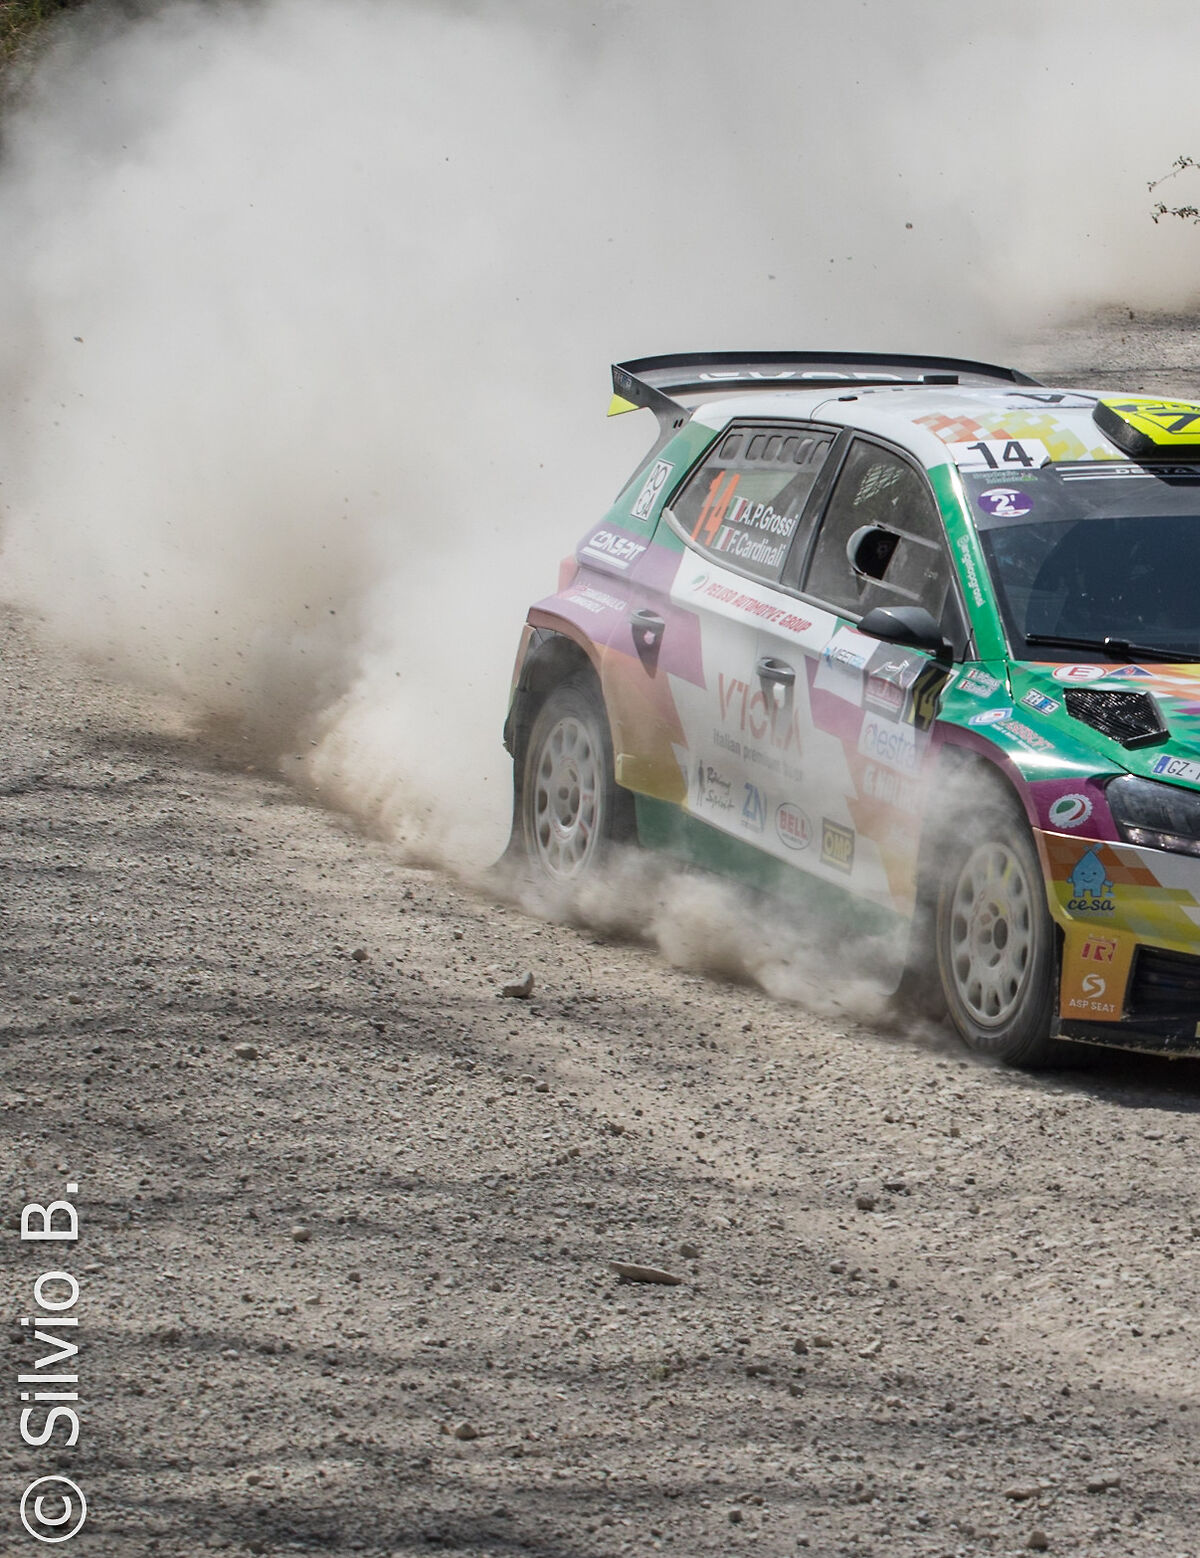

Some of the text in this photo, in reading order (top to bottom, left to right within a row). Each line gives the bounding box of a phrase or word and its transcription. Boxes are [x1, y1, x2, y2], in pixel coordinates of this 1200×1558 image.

[967, 441, 1034, 469] 14
[689, 470, 741, 547] 14
[779, 810, 808, 840] BELL
[825, 833, 851, 864] OMP
[1067, 899, 1116, 911] cesa
[1069, 999, 1116, 1013] ASP SEAT
